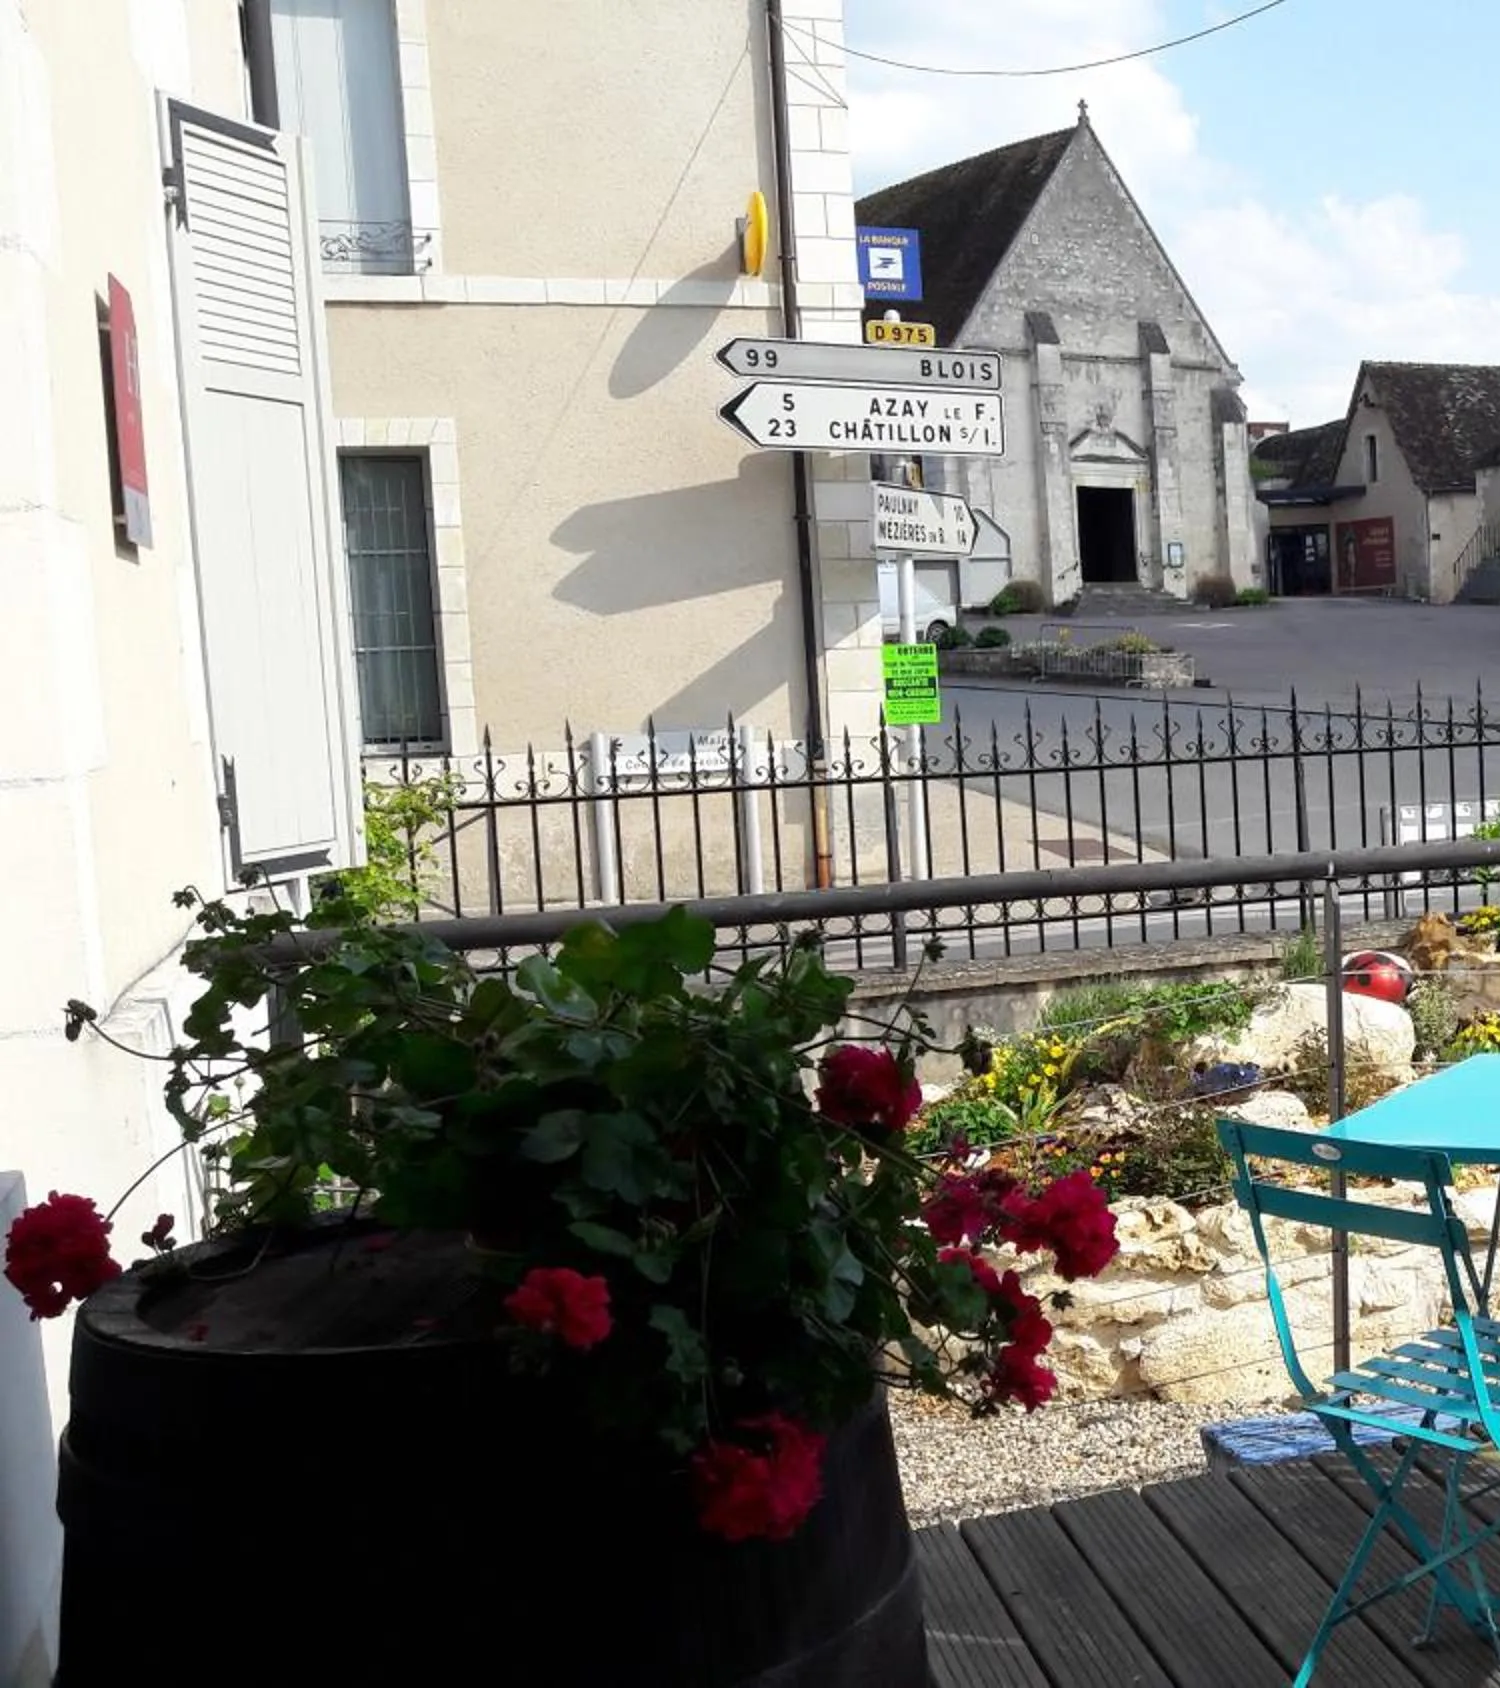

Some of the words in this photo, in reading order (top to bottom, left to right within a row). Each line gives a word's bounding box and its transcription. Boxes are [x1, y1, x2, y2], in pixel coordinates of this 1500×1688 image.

[874, 325, 885, 340] D
[891, 327, 928, 343] 975
[745, 348, 779, 368] 99
[920, 359, 993, 381] BLOIS
[782, 393, 796, 412] 5
[869, 397, 929, 418] AZAY
[943, 407, 962, 420] LE
[974, 403, 996, 422] F.
[768, 418, 798, 438] 23
[829, 418, 951, 443] CHÂTILLON
